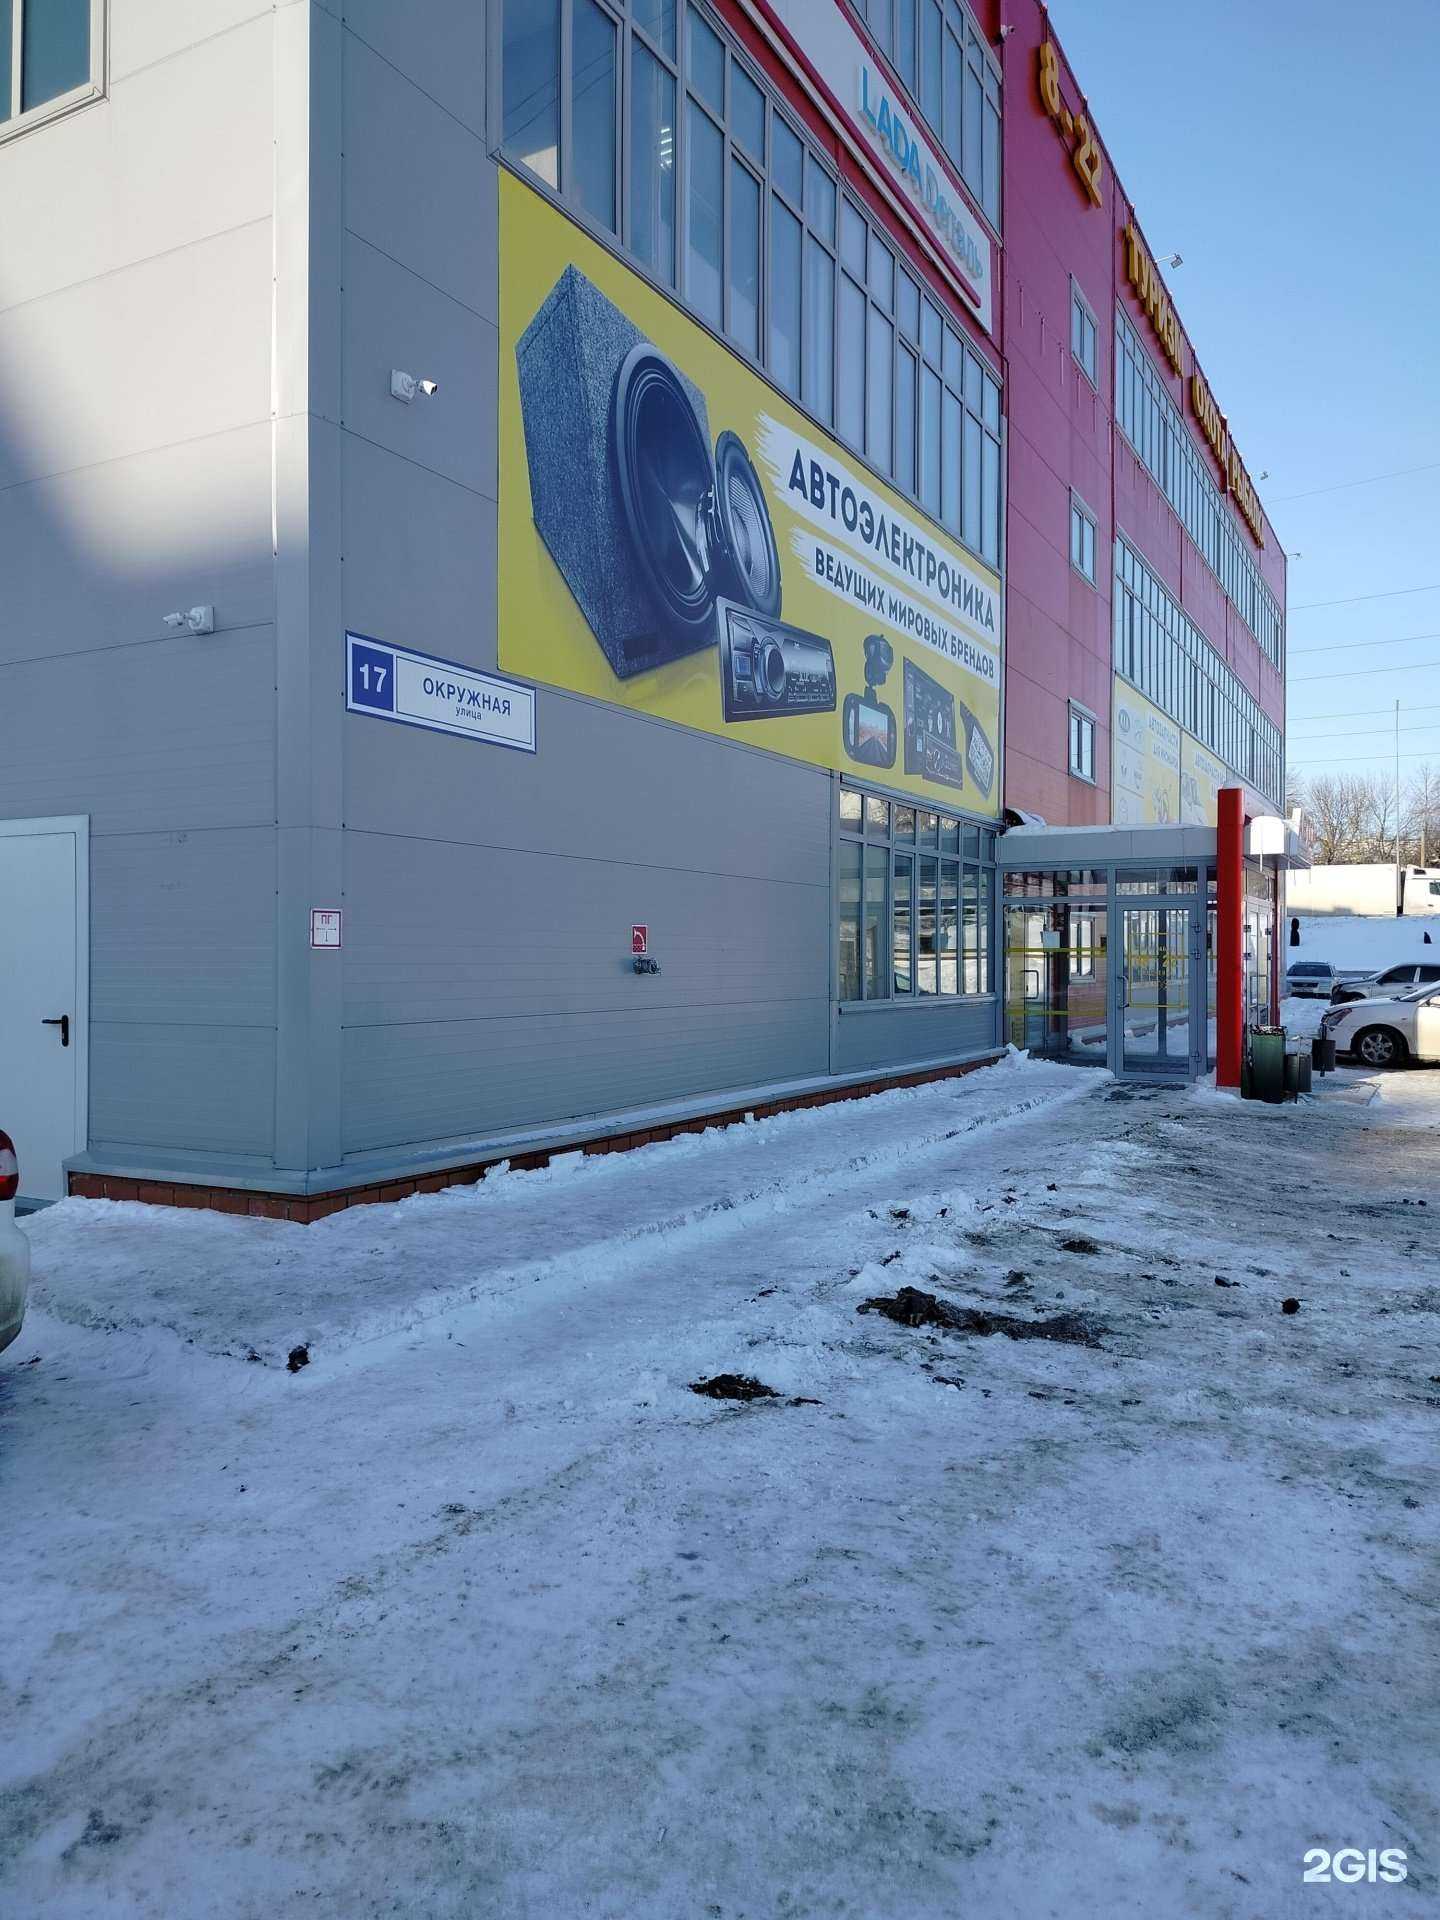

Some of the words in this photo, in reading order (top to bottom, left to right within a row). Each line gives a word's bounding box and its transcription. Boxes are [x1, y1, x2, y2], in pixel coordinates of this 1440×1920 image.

[858, 63, 923, 194] LADA
[1125, 223, 1184, 379] ТУРИЗМ
[1192, 375, 1228, 472] ОХОТА
[788, 448, 995, 633] АВТОЭЛЕКТРОНИКА
[815, 547, 885, 614] ВЕДУЩИХ
[888, 596, 948, 653] МИРОВЫХ
[949, 635, 995, 680] БРЕНДОВ
[359, 663, 387, 693] 17
[423, 677, 512, 716] ОКРУЖНАЯ
[455, 706, 482, 720] улица
